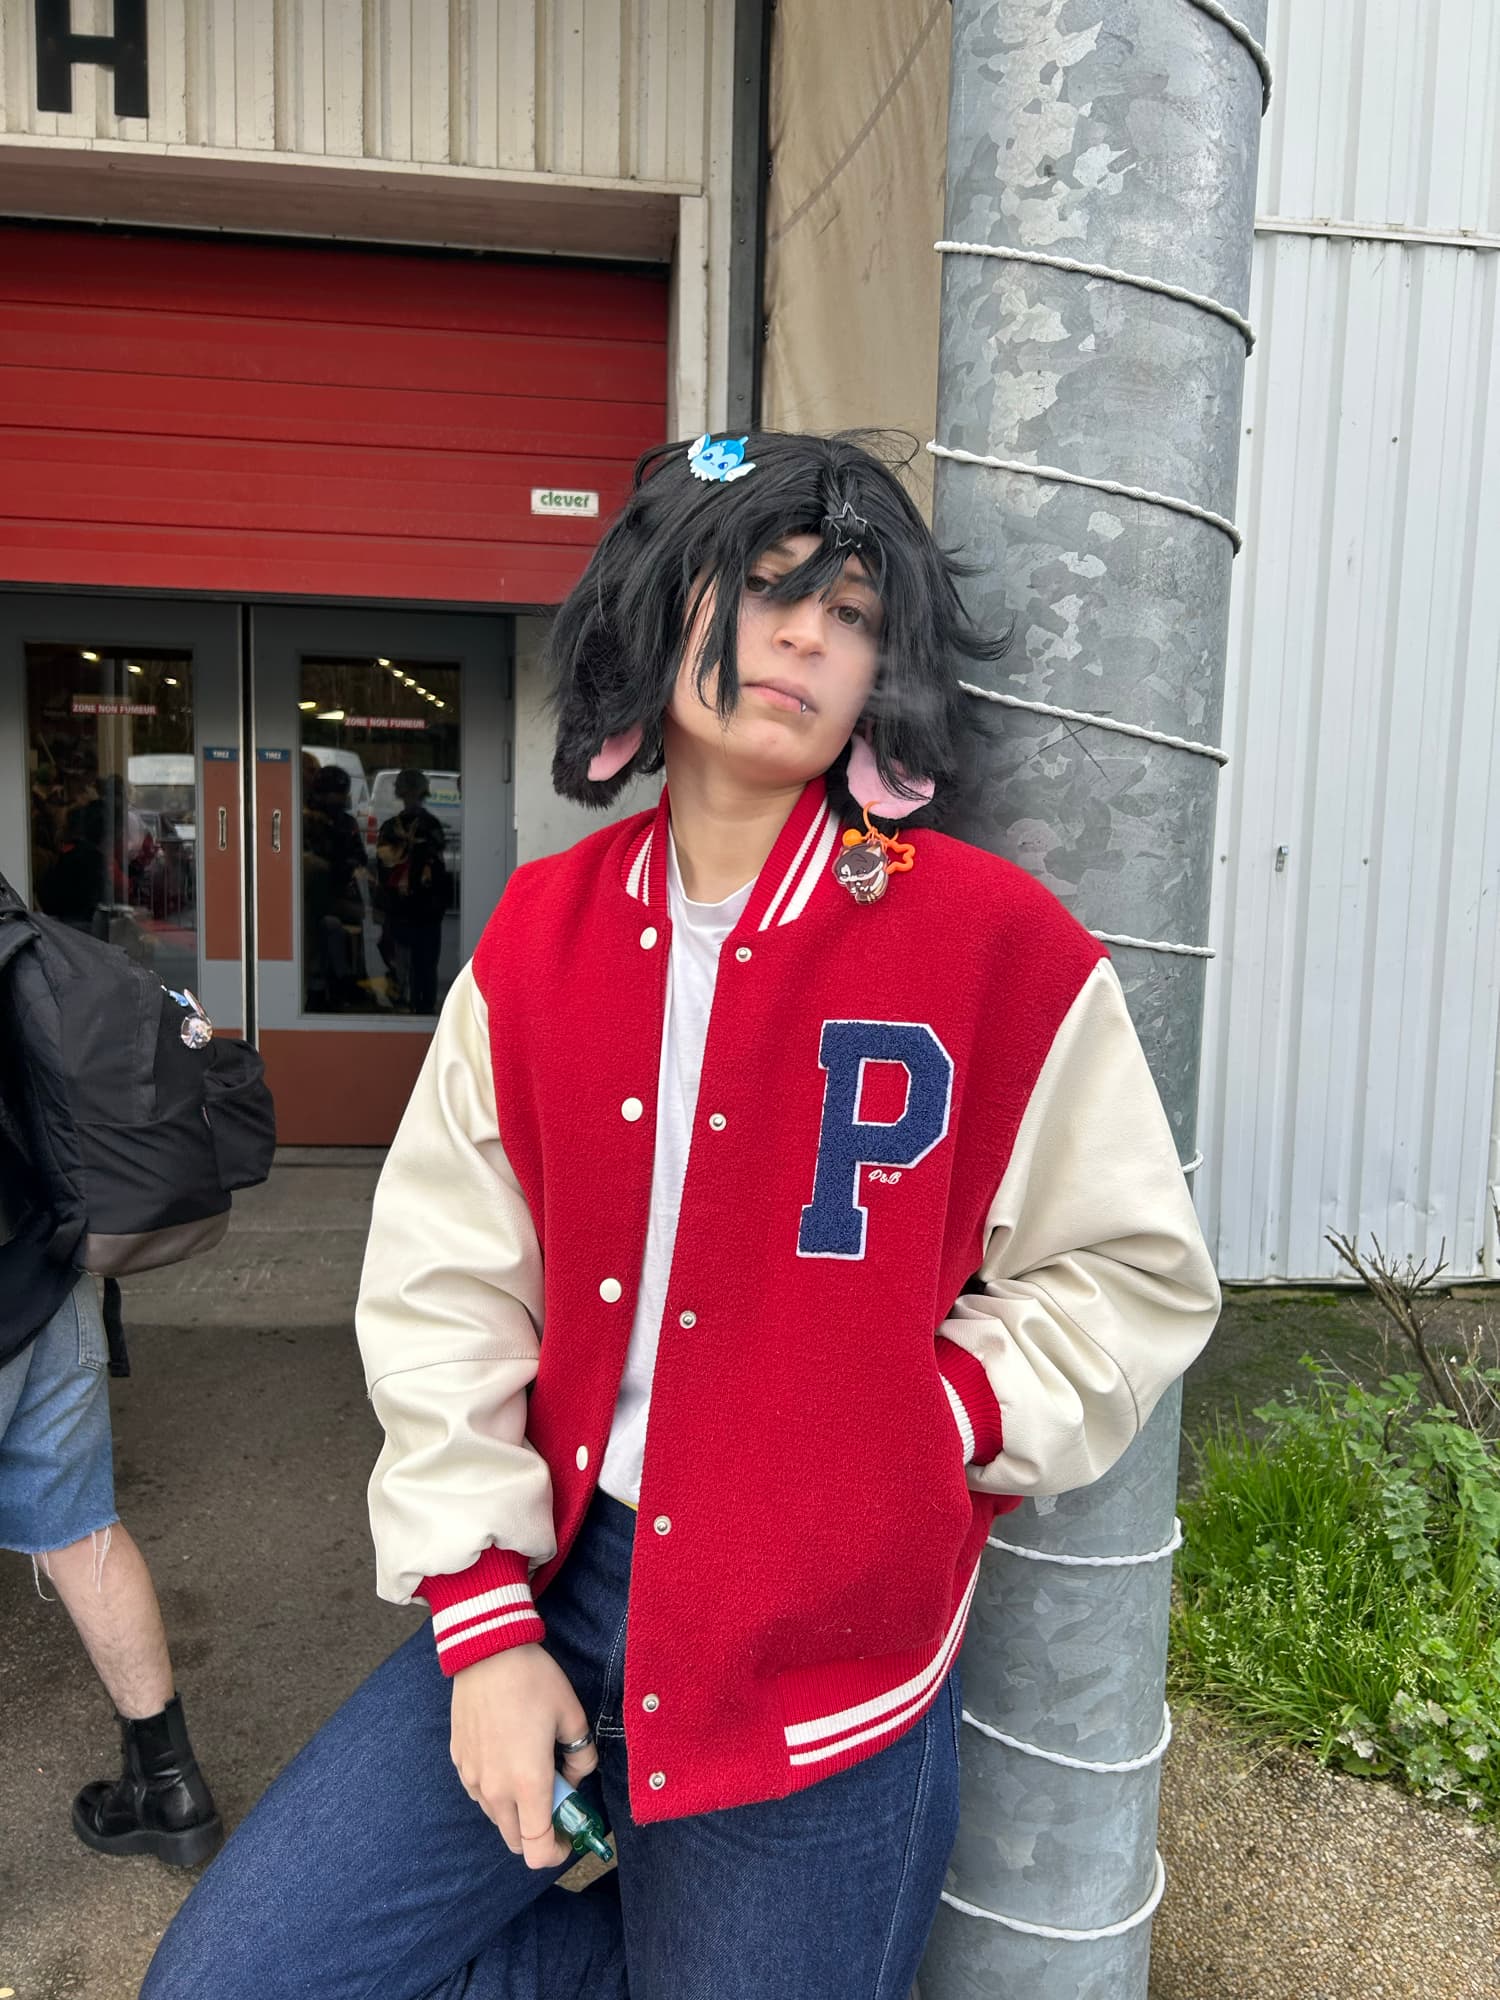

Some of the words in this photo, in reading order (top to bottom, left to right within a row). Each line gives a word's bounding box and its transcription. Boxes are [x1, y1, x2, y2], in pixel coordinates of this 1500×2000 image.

[35, 0, 149, 118] H
[540, 491, 589, 508] clever
[72, 703, 97, 713] ZONE
[98, 704, 118, 714] NON
[119, 704, 156, 715] FUMEUR
[345, 717, 368, 727] ZONE
[369, 718, 388, 728] NON
[390, 718, 425, 729] FUMEUR
[796, 1019, 954, 1261] P
[867, 1168, 903, 1185] P&B
